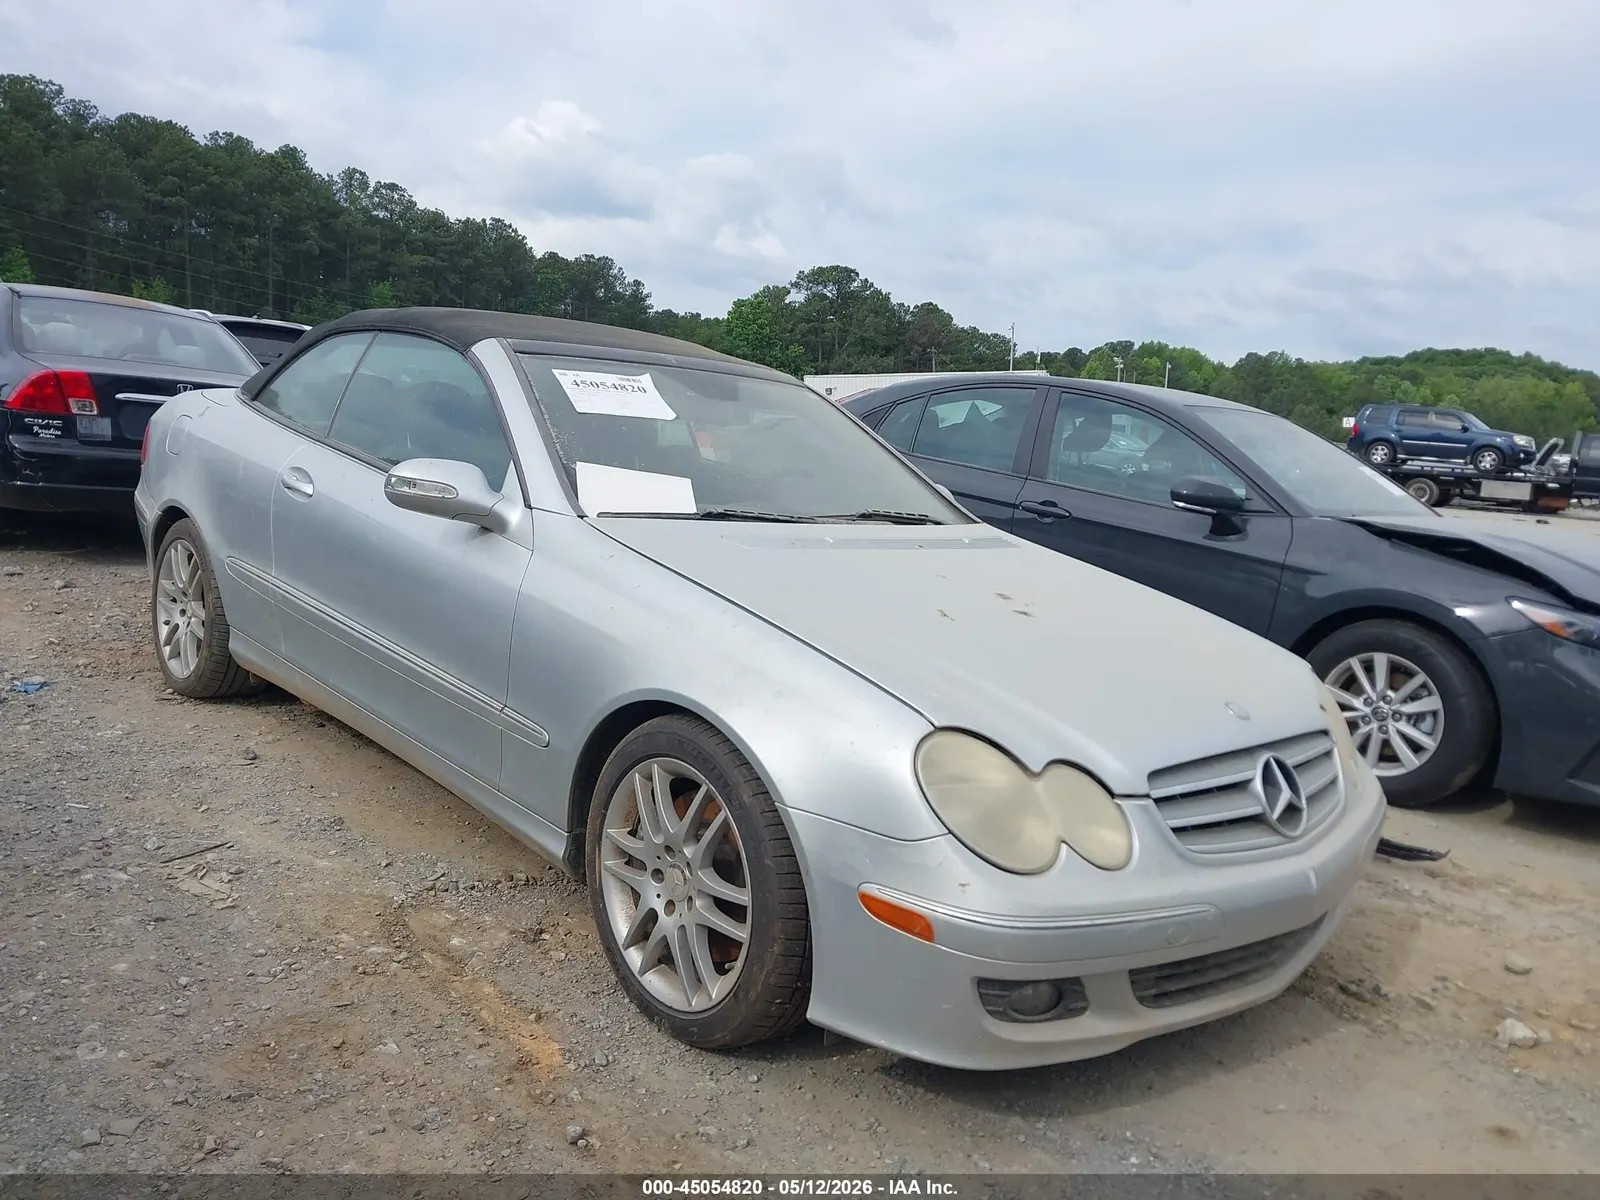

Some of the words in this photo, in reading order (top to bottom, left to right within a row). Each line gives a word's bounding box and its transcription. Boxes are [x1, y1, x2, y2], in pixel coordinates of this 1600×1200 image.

[571, 379, 647, 394] 45054820
[24, 417, 63, 427] CIVIC
[32, 425, 62, 435] Paradise
